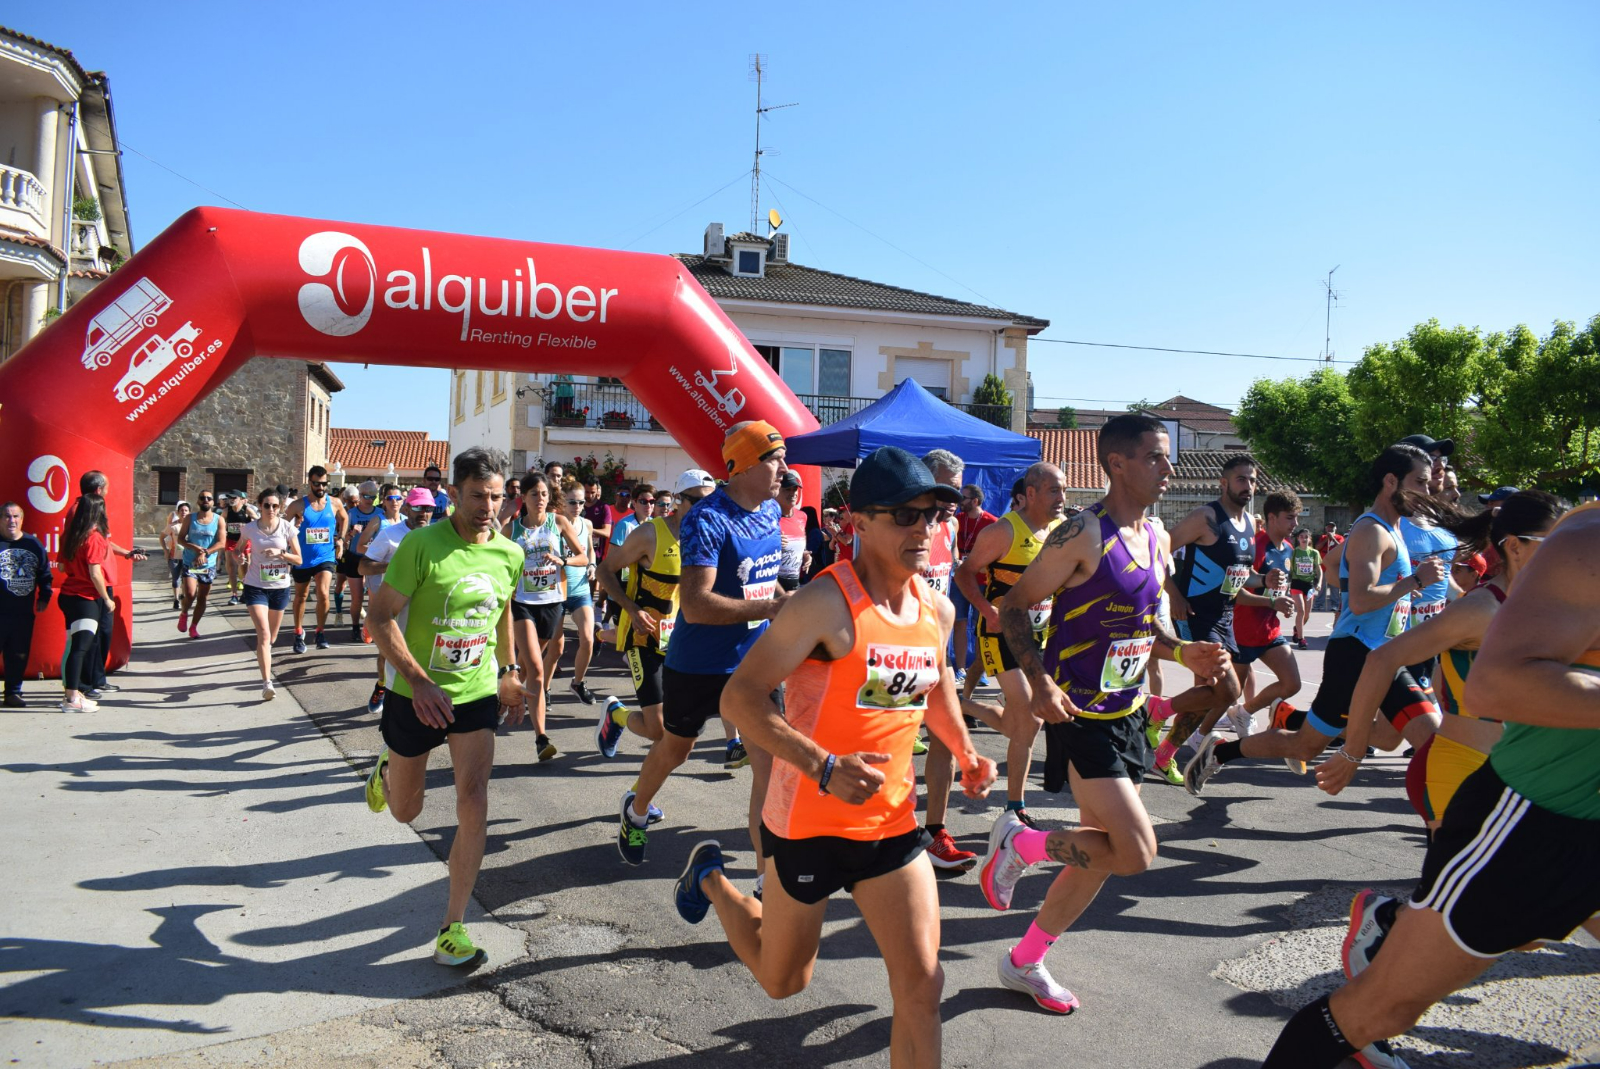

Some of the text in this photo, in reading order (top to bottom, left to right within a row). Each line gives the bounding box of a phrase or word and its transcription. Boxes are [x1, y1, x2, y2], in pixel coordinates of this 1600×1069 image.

[384, 246, 618, 342] alquiber
[470, 328, 597, 350] Renting Flexible
[126, 338, 223, 422] www.alquiber.es
[268, 568, 280, 577] 48
[533, 575, 548, 587] 75
[435, 635, 488, 649] bedunia
[449, 648, 471, 664] 31
[869, 648, 935, 670] bedunia
[1120, 657, 1140, 677] 97
[887, 671, 918, 696] 84
